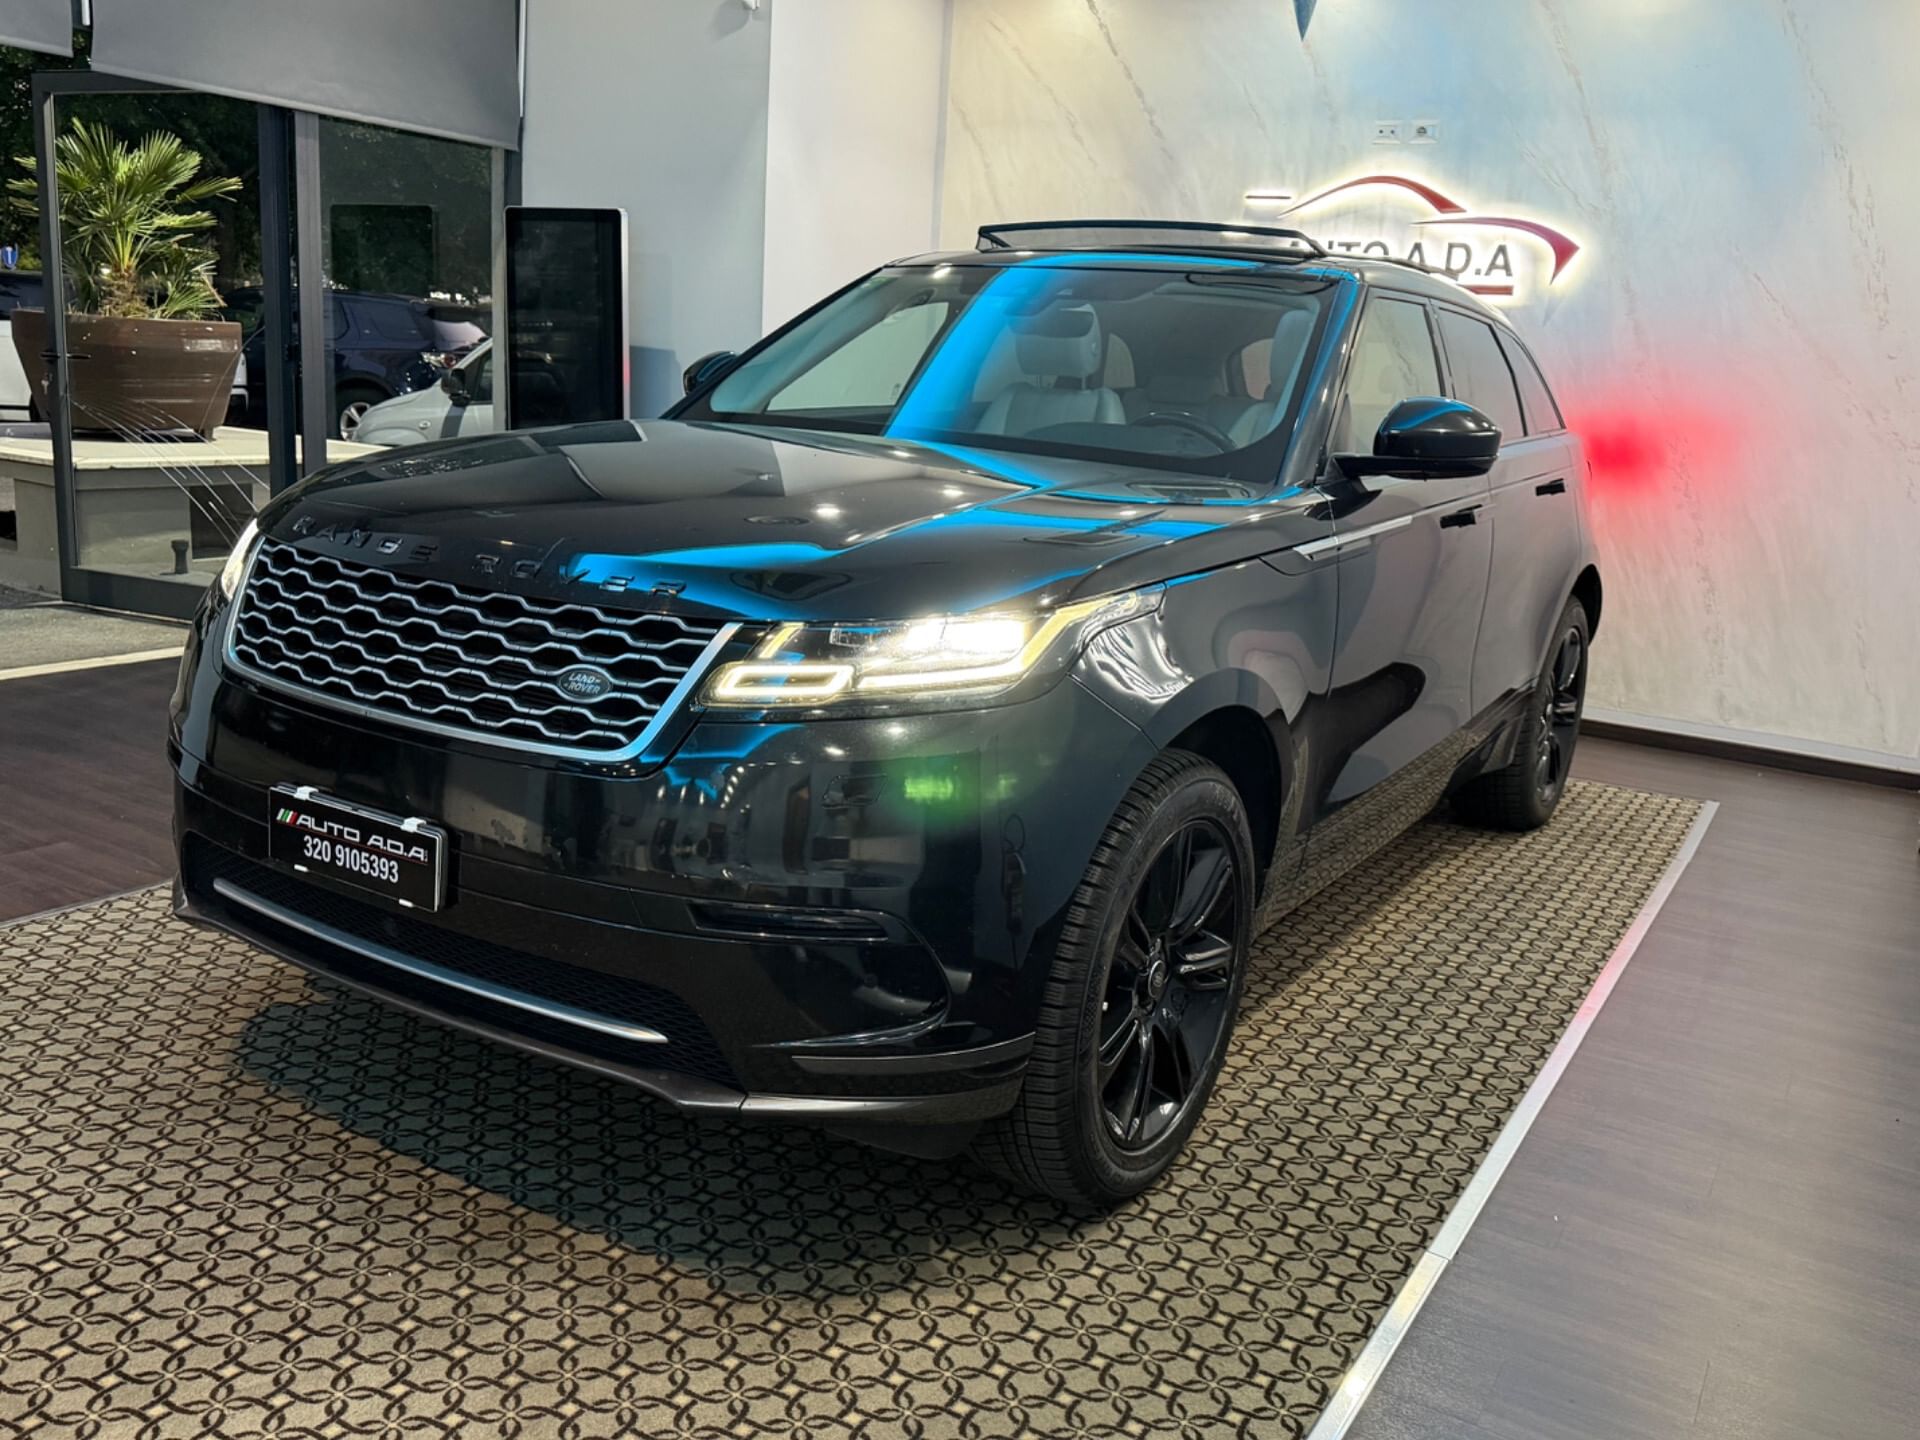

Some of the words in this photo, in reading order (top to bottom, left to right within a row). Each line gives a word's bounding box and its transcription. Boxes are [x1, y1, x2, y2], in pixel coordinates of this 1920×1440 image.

[292, 515, 438, 561] RANGE
[297, 814, 360, 842] AUTO
[303, 835, 331, 863] 320
[335, 845, 399, 883] 9105393
